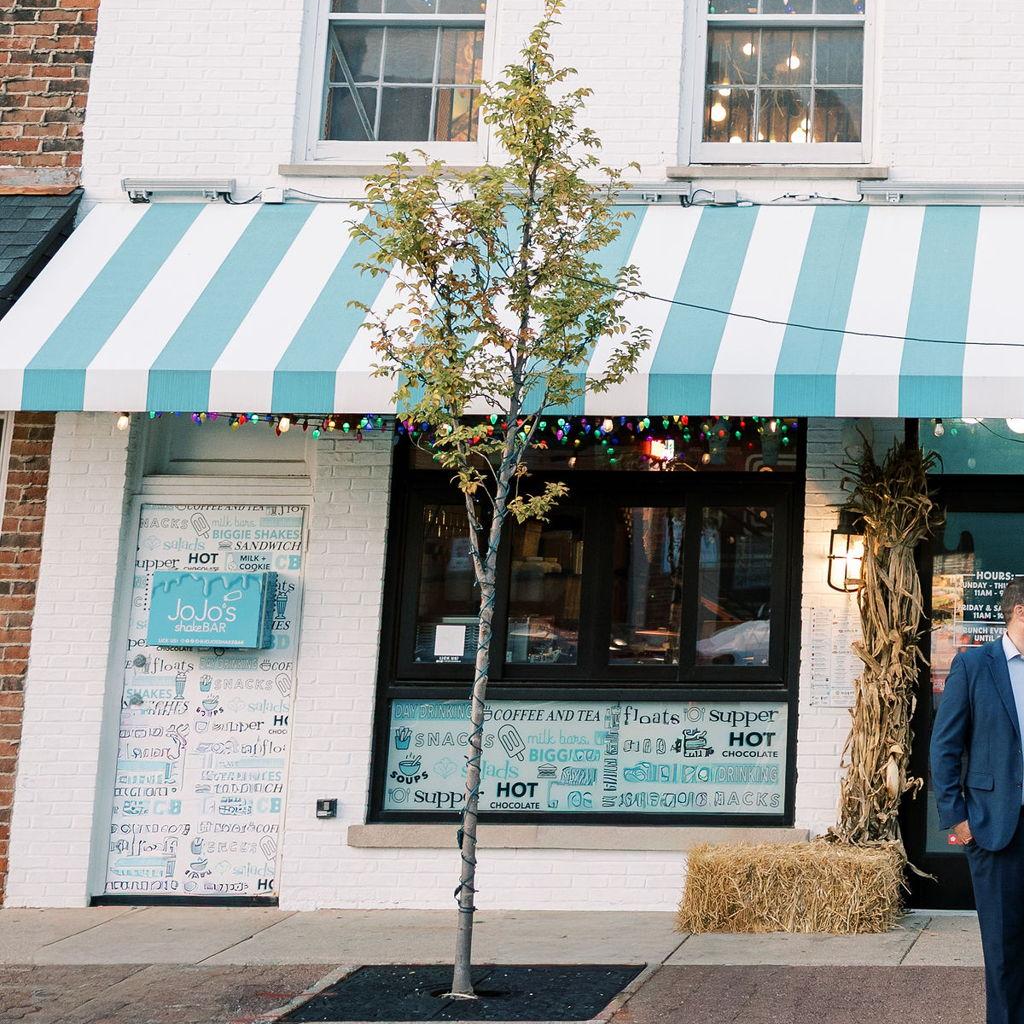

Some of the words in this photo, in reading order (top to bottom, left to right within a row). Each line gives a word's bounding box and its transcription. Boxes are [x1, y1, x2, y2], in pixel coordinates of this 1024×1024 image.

[212, 529, 252, 540] BIGGIE
[254, 530, 300, 541] SHAKES
[163, 538, 205, 551] salads
[188, 553, 219, 564] HOT
[239, 563, 271, 571] COOKIE
[976, 571, 1014, 581] HOURS:
[174, 621, 226, 633] shakeBAR
[151, 656, 195, 674] floats
[213, 679, 274, 691] SNACKS
[395, 704, 417, 718] DAY
[494, 709, 544, 721] COFFEE
[545, 709, 575, 721] AND
[577, 709, 601, 722] TEA
[623, 705, 680, 725] floats
[414, 731, 495, 749] SNACS
[729, 731, 776, 747] HOT
[721, 750, 779, 758] CHOCOLATE
[389, 770, 429, 784] SOUPS
[461, 760, 519, 781] slads
[496, 782, 539, 798] HOT
[489, 801, 540, 810] CHOCOLATE
